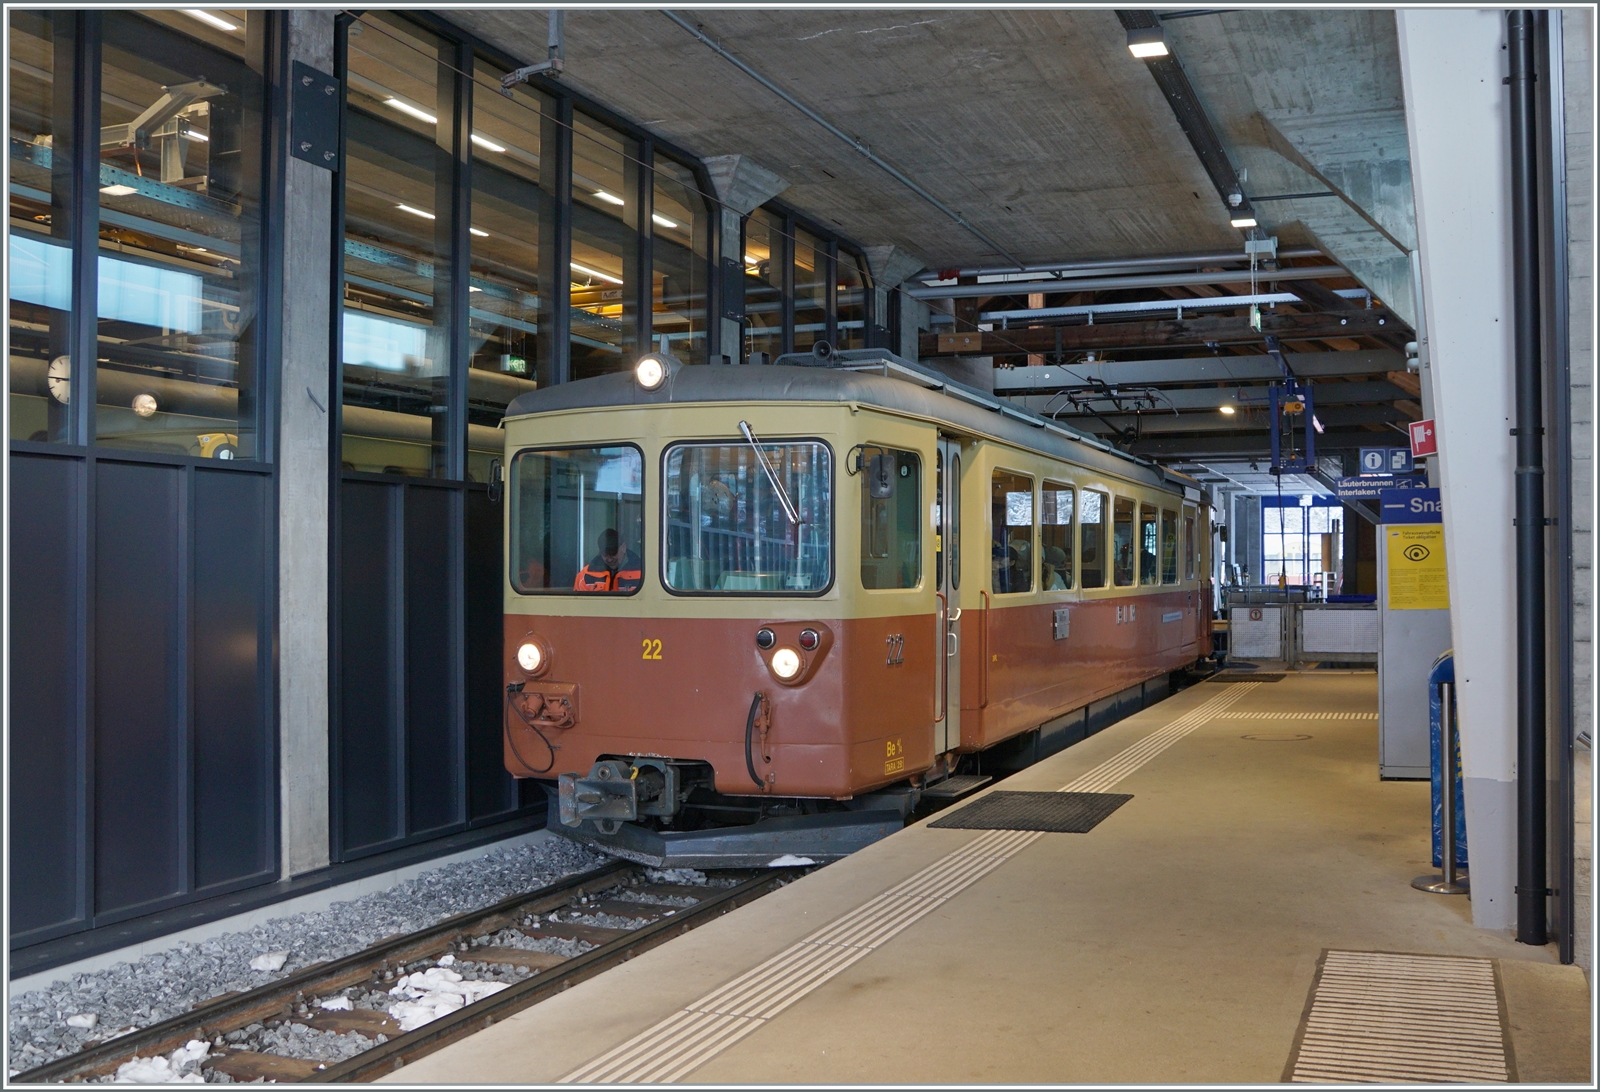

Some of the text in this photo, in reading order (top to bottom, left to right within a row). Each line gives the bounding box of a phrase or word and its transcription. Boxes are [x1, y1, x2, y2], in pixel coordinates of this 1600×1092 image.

[1338, 480, 1393, 488] Lauterbrunnen
[642, 638, 663, 660] 22
[886, 633, 904, 665] 22
[886, 741, 896, 757] Be
